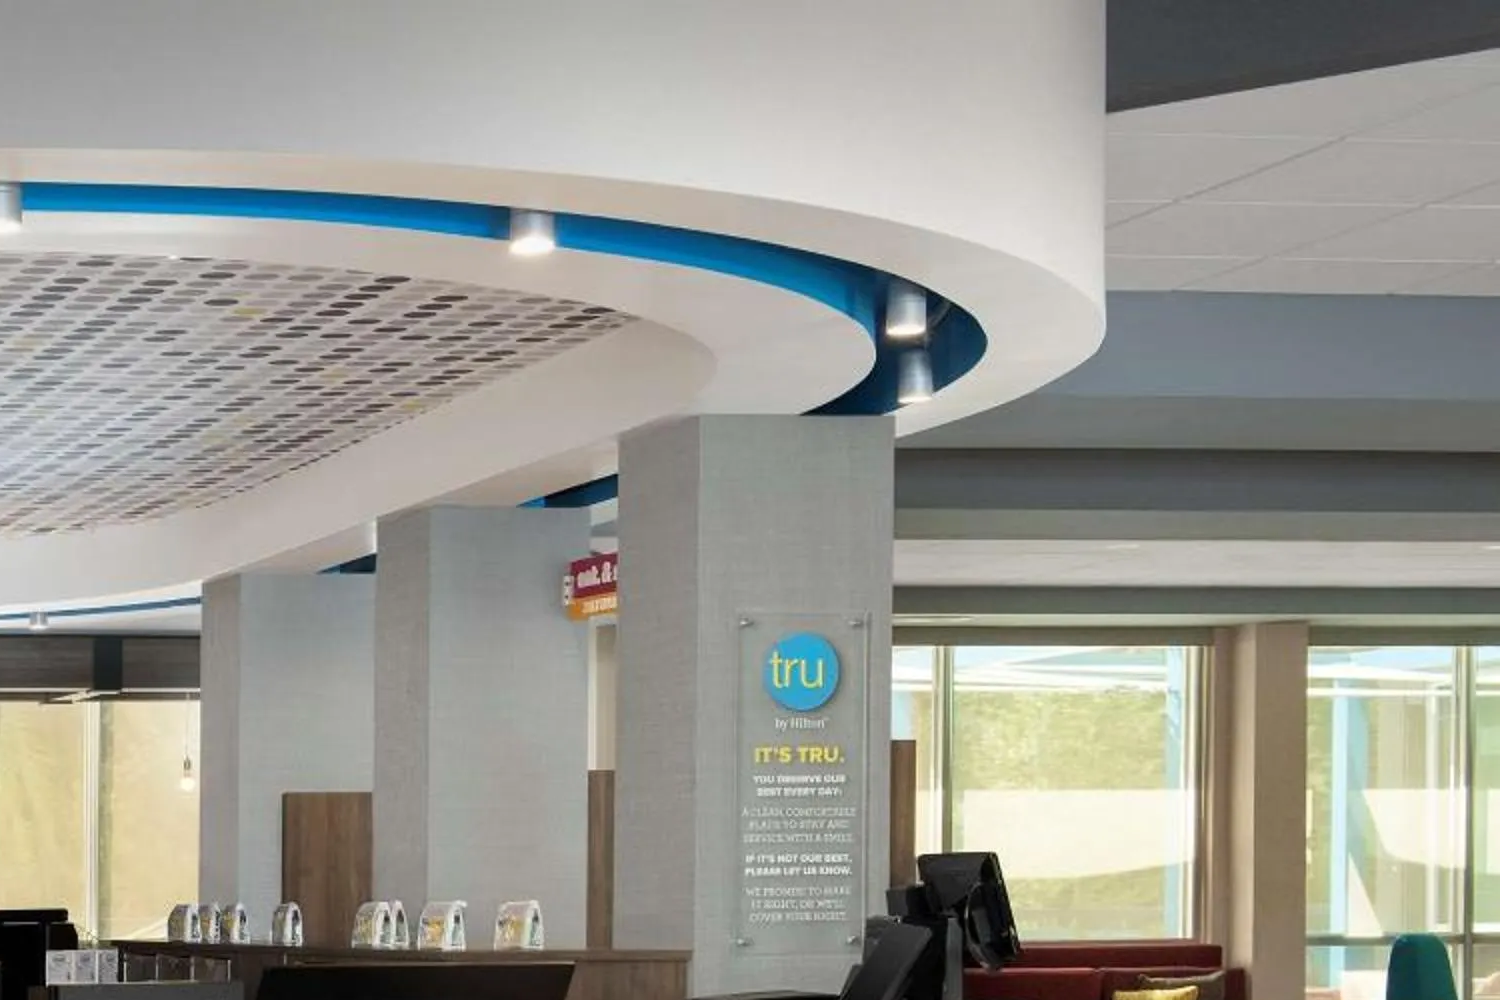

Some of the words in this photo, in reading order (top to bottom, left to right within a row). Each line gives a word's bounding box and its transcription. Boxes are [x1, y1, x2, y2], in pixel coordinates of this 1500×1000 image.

[769, 650, 824, 688] tru
[774, 717, 789, 732] by
[755, 747, 792, 763] IT'S
[796, 746, 845, 763] TRU.
[753, 775, 775, 784] YOU
[745, 854, 755, 863] IF
[777, 854, 798, 863] NOT
